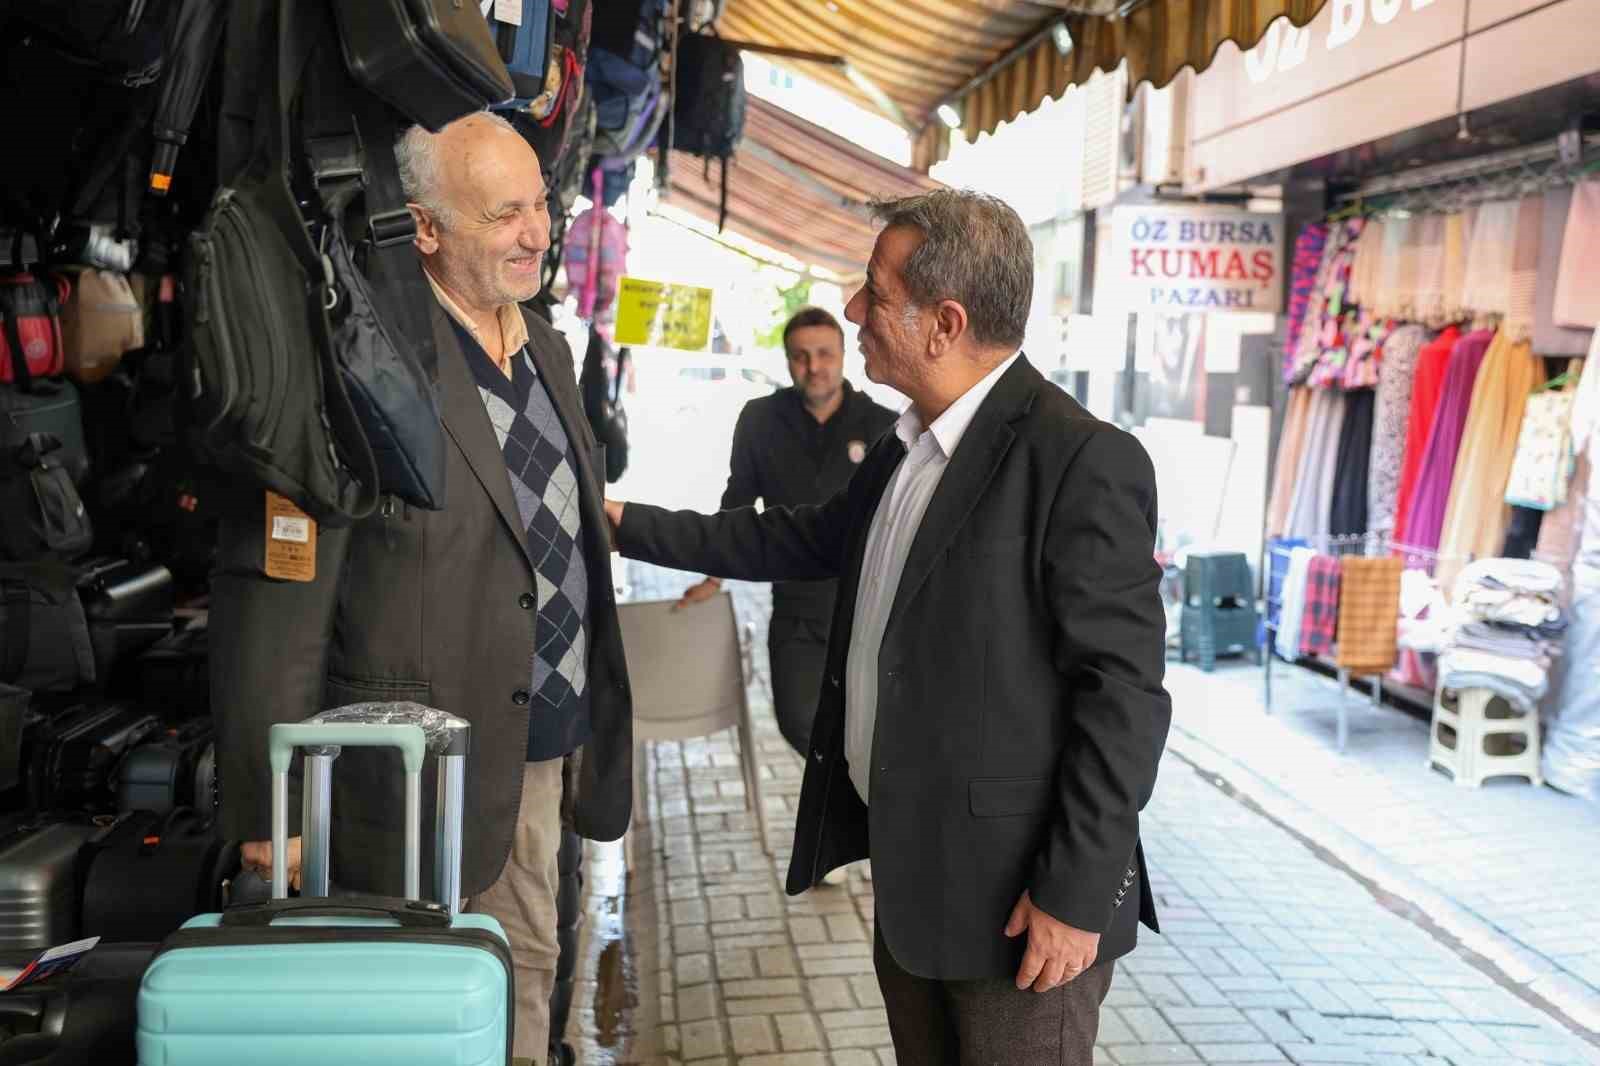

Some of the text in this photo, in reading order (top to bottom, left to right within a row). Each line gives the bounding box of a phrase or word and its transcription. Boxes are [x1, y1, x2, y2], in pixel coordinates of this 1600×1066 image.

[1131, 215, 1274, 243] ÖZ BURSA
[1130, 248, 1274, 288] KUMAŞ
[1151, 288, 1256, 307] PAZARI
